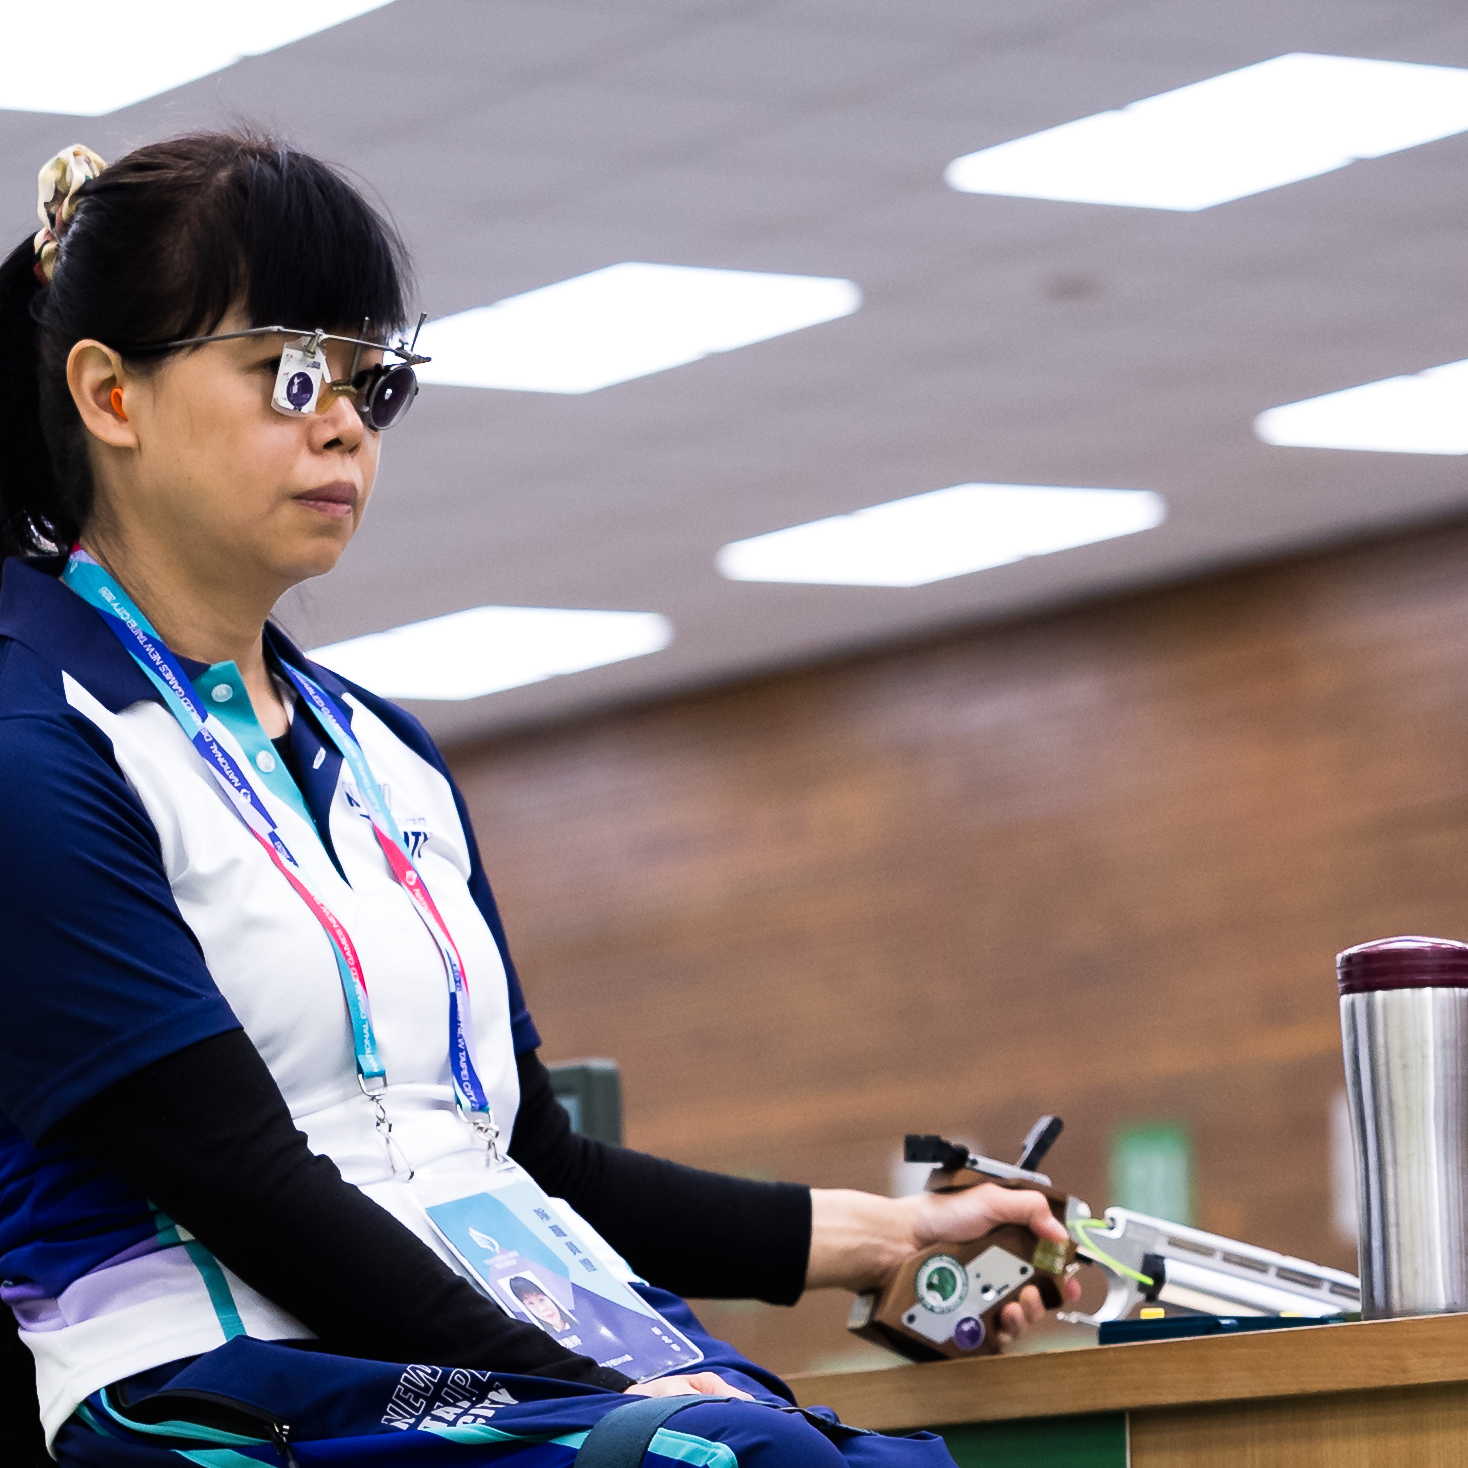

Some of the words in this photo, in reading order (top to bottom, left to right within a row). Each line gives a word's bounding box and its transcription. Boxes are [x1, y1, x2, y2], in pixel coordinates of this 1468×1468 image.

[111, 602, 131, 623] CITY
[143, 643, 164, 666] NEW
[158, 664, 185, 699] GAMES
[381, 1364, 442, 1430] NEW
